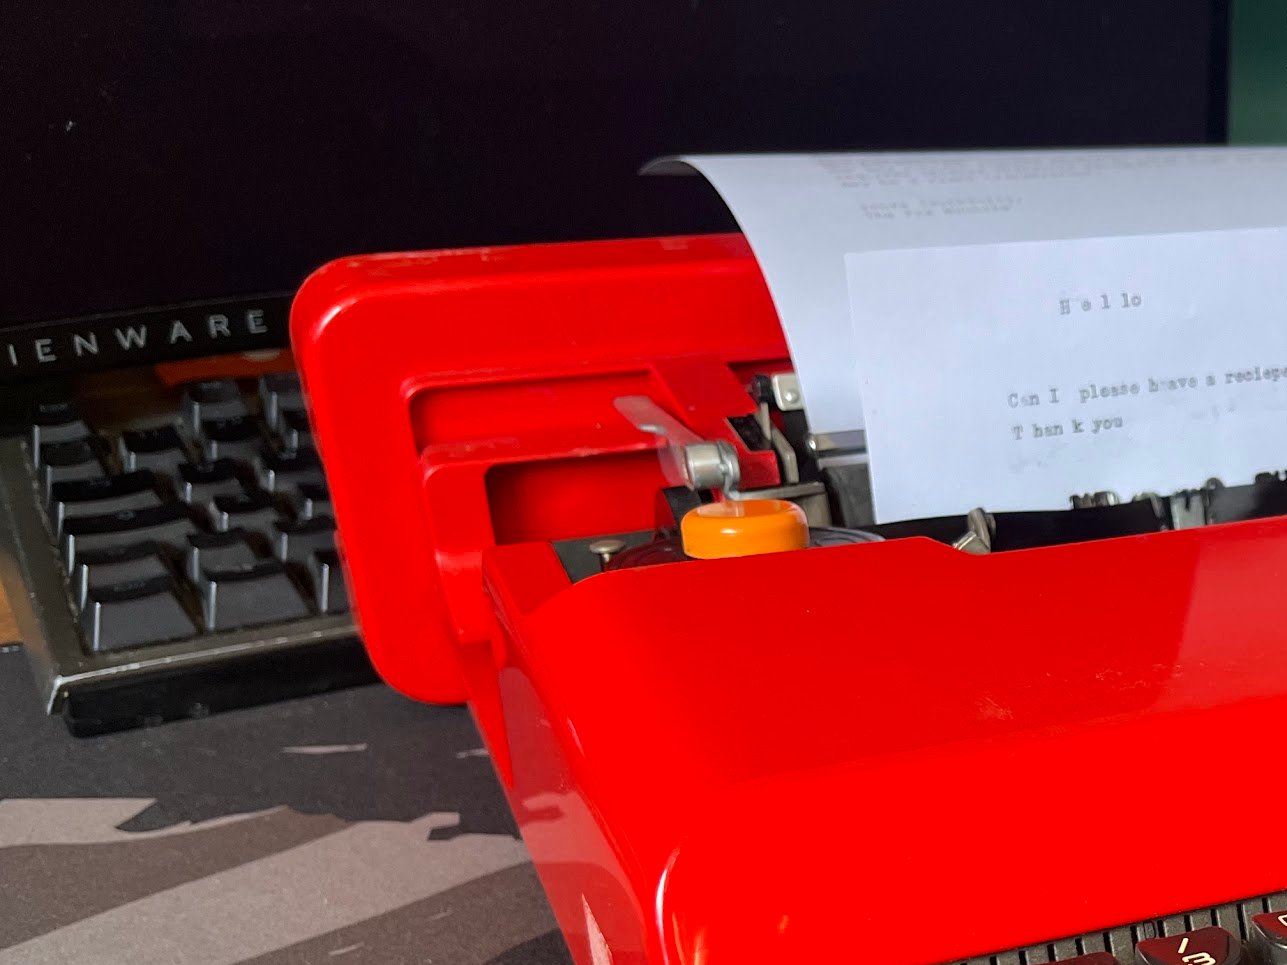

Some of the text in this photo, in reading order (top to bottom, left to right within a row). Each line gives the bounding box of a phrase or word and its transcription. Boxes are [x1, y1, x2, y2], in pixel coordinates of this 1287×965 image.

[7, 308, 269, 367] IENWARE
[1079, 383, 1140, 403] please
[1205, 375, 1216, 387] a
[1091, 416, 1124, 434] you
